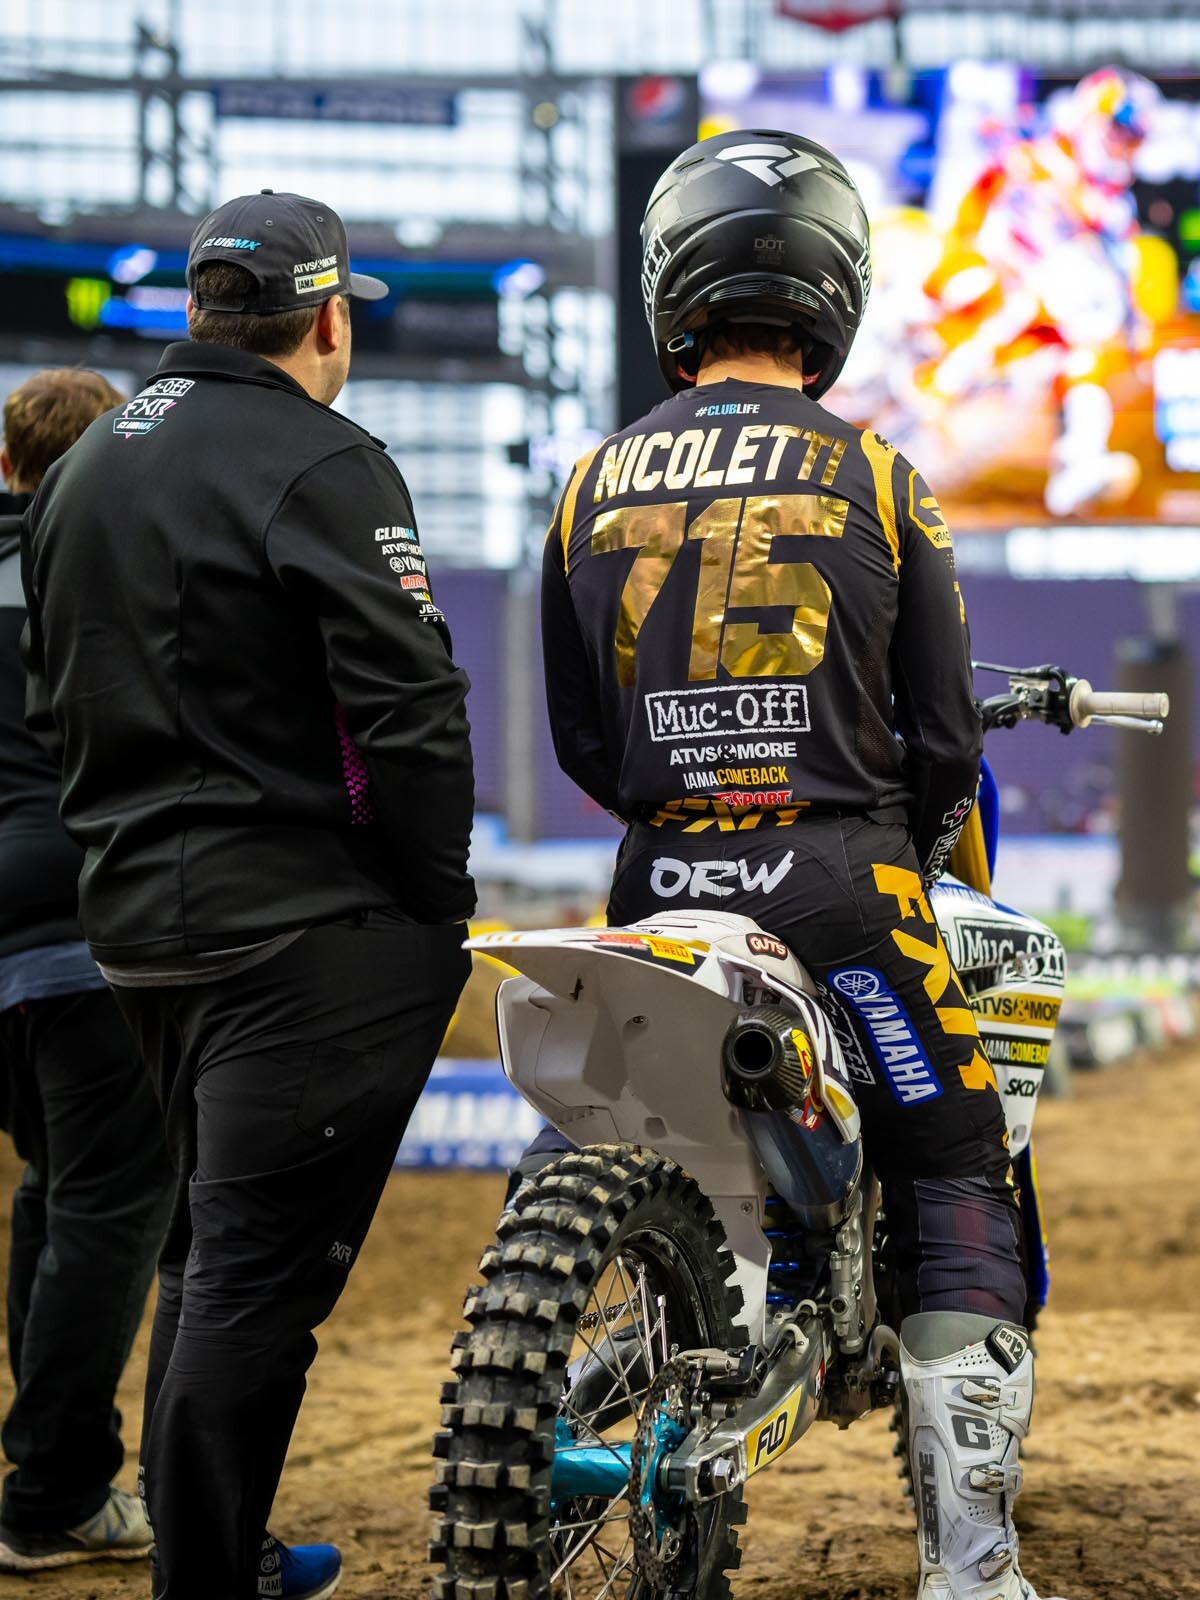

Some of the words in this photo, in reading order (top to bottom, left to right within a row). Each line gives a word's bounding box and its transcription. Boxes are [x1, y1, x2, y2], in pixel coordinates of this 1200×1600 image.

[201, 237, 262, 251] CLUBMX
[754, 238, 784, 250] DOT
[122, 398, 174, 415] FXR
[695, 403, 760, 417] #CLUBLIFE
[593, 424, 848, 504] NICOLETTI
[375, 526, 417, 541] CLUBM
[591, 494, 850, 689] 715
[653, 690, 799, 734] Muc-Off
[669, 741, 798, 766] ATVS&MORE
[683, 766, 789, 790] IAMACOMEBACK
[649, 851, 795, 898] ORW
[750, 937, 786, 955] GUTS
[852, 991, 939, 1104] YAMAHA
[985, 1039, 1050, 1064] IAMACOMEBA
[753, 1410, 788, 1467] FLO
